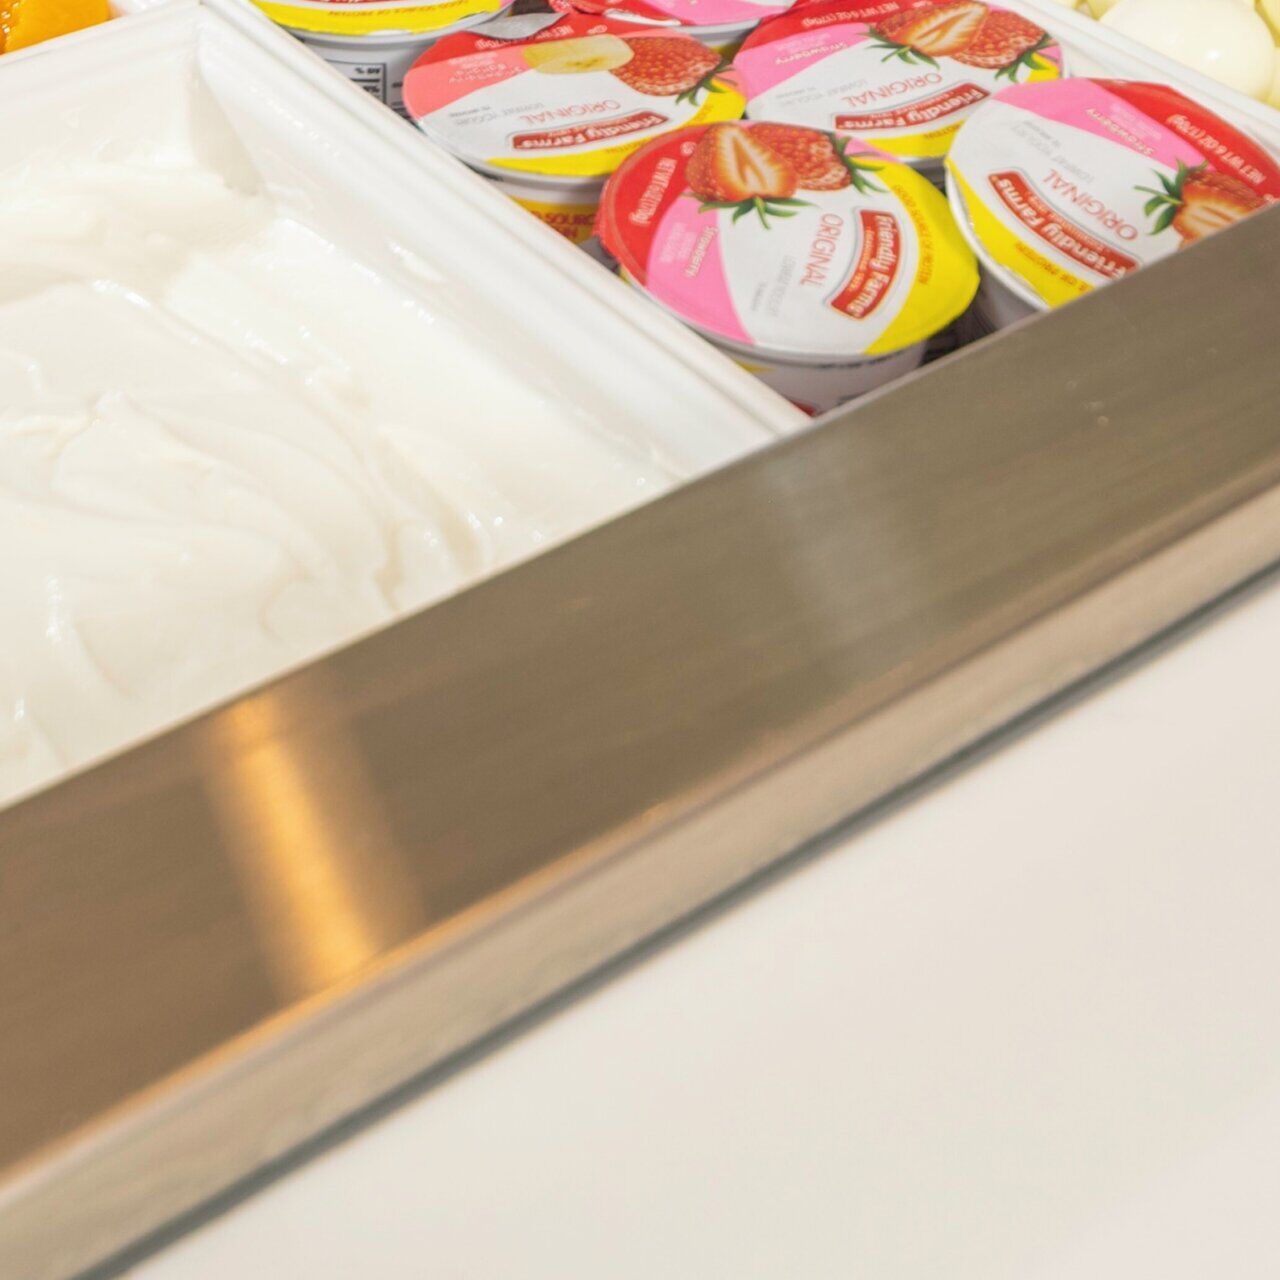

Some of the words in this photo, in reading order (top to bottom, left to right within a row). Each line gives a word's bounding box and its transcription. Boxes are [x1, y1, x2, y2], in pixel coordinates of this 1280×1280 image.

[525, 99, 622, 125] ORIGINAL
[841, 72, 943, 108] ORIGINAL
[907, 88, 985, 124] Friendly
[521, 133, 587, 148] Farms
[586, 114, 664, 139] Friendly
[844, 116, 907, 128] Farms
[1085, 108, 1156, 156] Strawberry
[996, 178, 1045, 227] Farms
[1043, 170, 1138, 241] ORIGINAL
[798, 213, 844, 287] ORIGINAL
[870, 215, 898, 271] Friendly
[1042, 222, 1126, 279] Friendly
[846, 271, 890, 317] Farms
